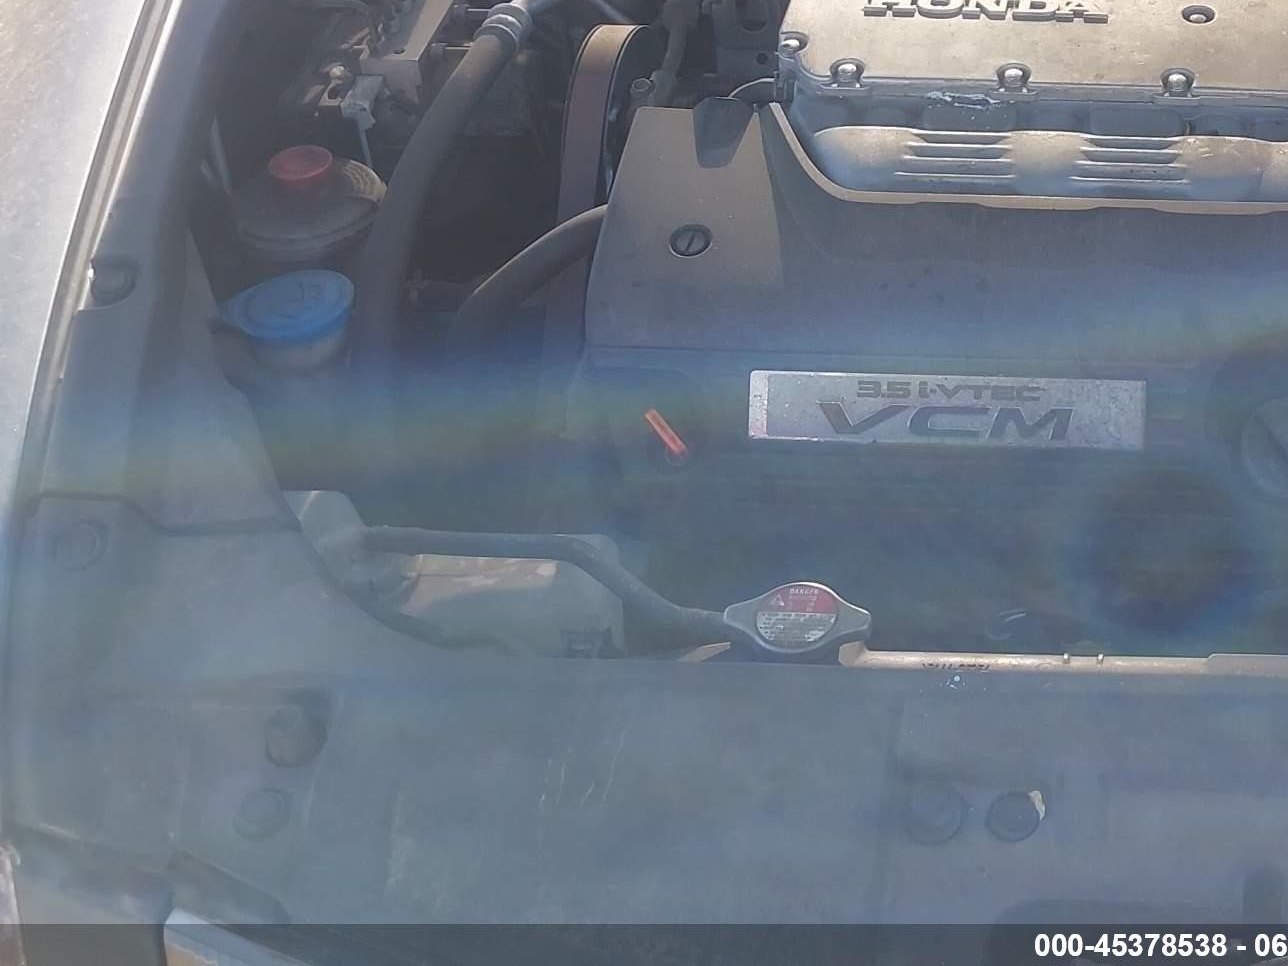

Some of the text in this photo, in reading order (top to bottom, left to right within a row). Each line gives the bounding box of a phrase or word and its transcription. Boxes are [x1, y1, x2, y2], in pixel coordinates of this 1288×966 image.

[856, 379, 1042, 402] 3.5 i-VTEC
[816, 401, 1074, 441] VCM
